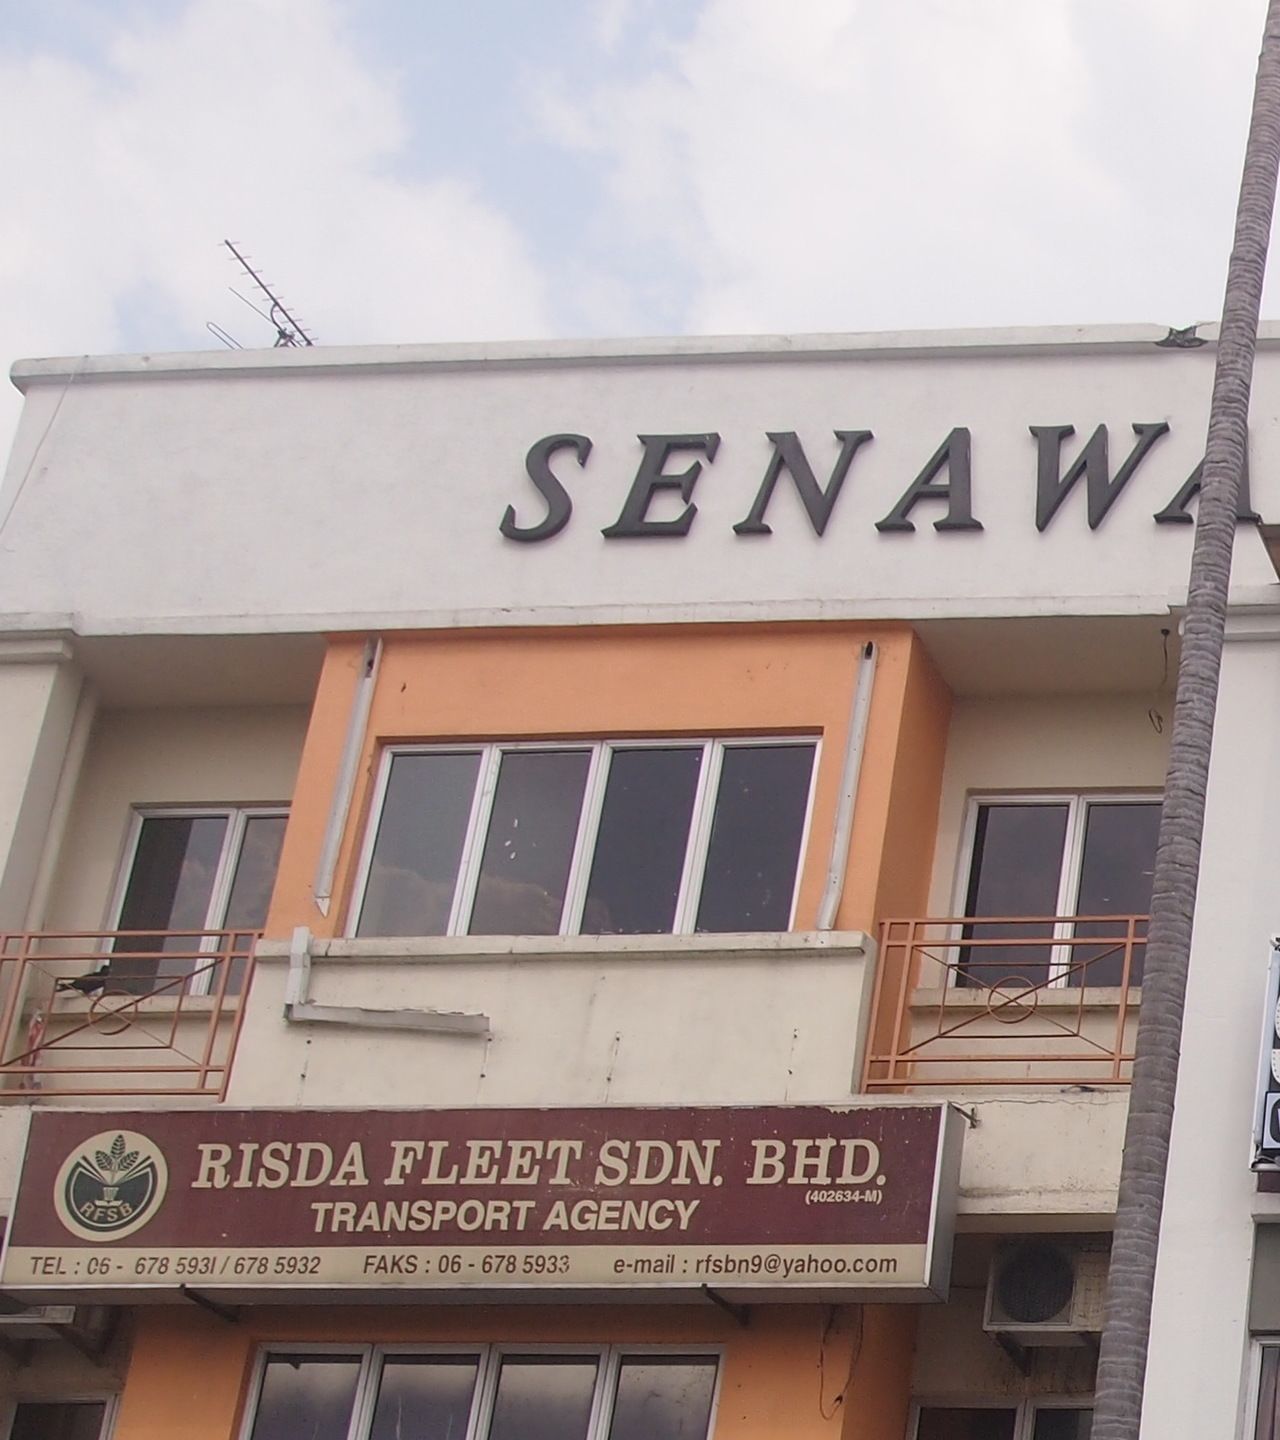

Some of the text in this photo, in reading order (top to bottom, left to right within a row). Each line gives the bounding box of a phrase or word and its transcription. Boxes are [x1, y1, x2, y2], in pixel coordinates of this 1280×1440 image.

[191, 1138, 887, 1190] RISDA FLEET SDN. BHD.
[804, 1189, 883, 1204] (402634-M)
[80, 1201, 135, 1223] RFSB
[310, 1198, 700, 1234] TRANSPORT AGENCY
[30, 1256, 67, 1275] TEL
[87, 1256, 111, 1276] 06
[134, 1256, 170, 1275] 678
[233, 1256, 270, 1275] 678
[273, 1256, 322, 1275] 5932
[363, 1255, 419, 1275] FAKS
[437, 1255, 462, 1275] 06
[481, 1255, 521, 1275] 678
[522, 1255, 570, 1275] 5933
[613, 1253, 676, 1275] e-mail
[695, 1253, 898, 1279] rfsbn9@yahoo.com
